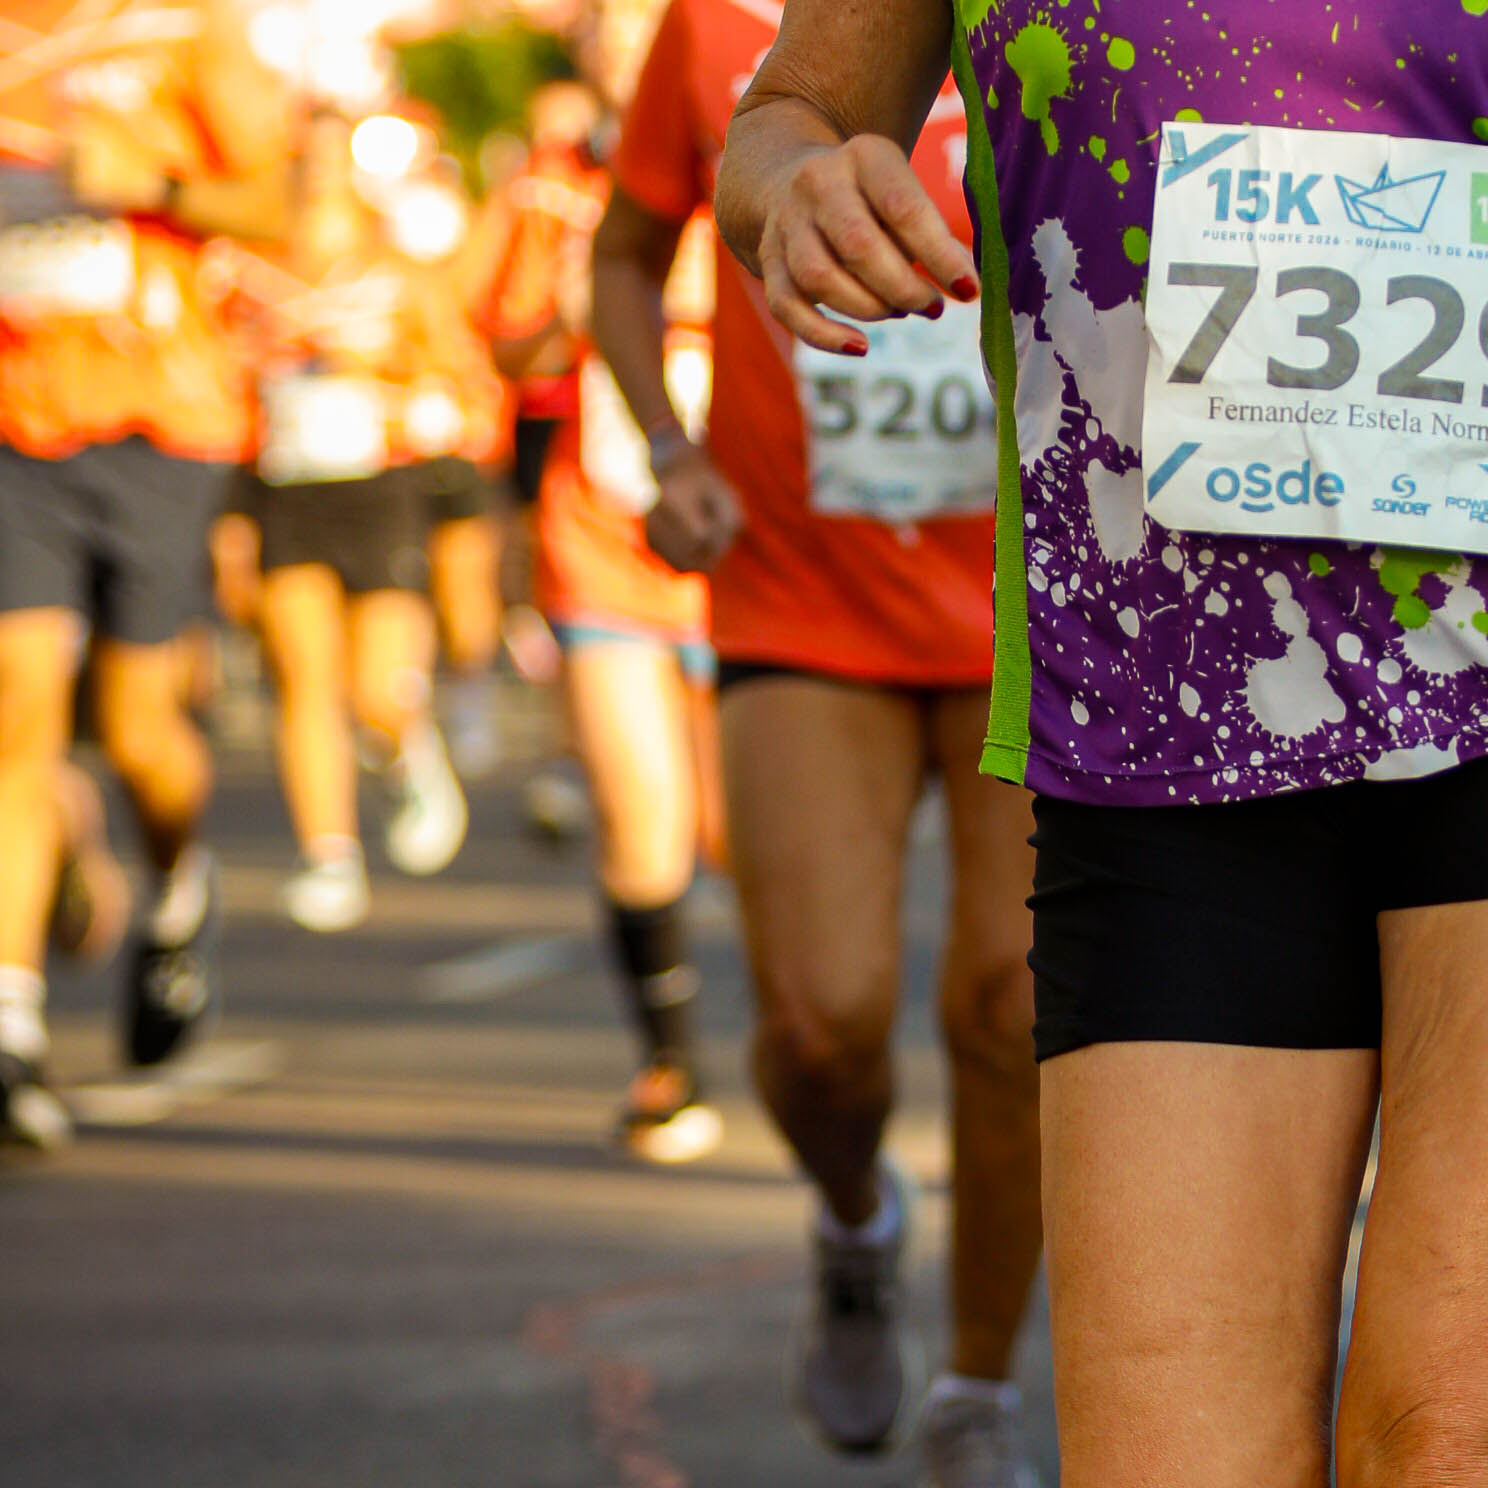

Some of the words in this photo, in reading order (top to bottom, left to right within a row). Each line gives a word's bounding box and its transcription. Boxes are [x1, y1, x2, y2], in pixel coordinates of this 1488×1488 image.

[1206, 167, 1324, 226] 15K
[1202, 229, 1254, 242] PUERTO
[1258, 232, 1303, 244] NORTE
[1307, 234, 1340, 245] 2026
[1446, 246, 1462, 258] DE
[811, 373, 998, 441] 520
[1207, 396, 1338, 426] Fernandez
[1347, 403, 1423, 434] Estela
[1205, 458, 1345, 513] osde
